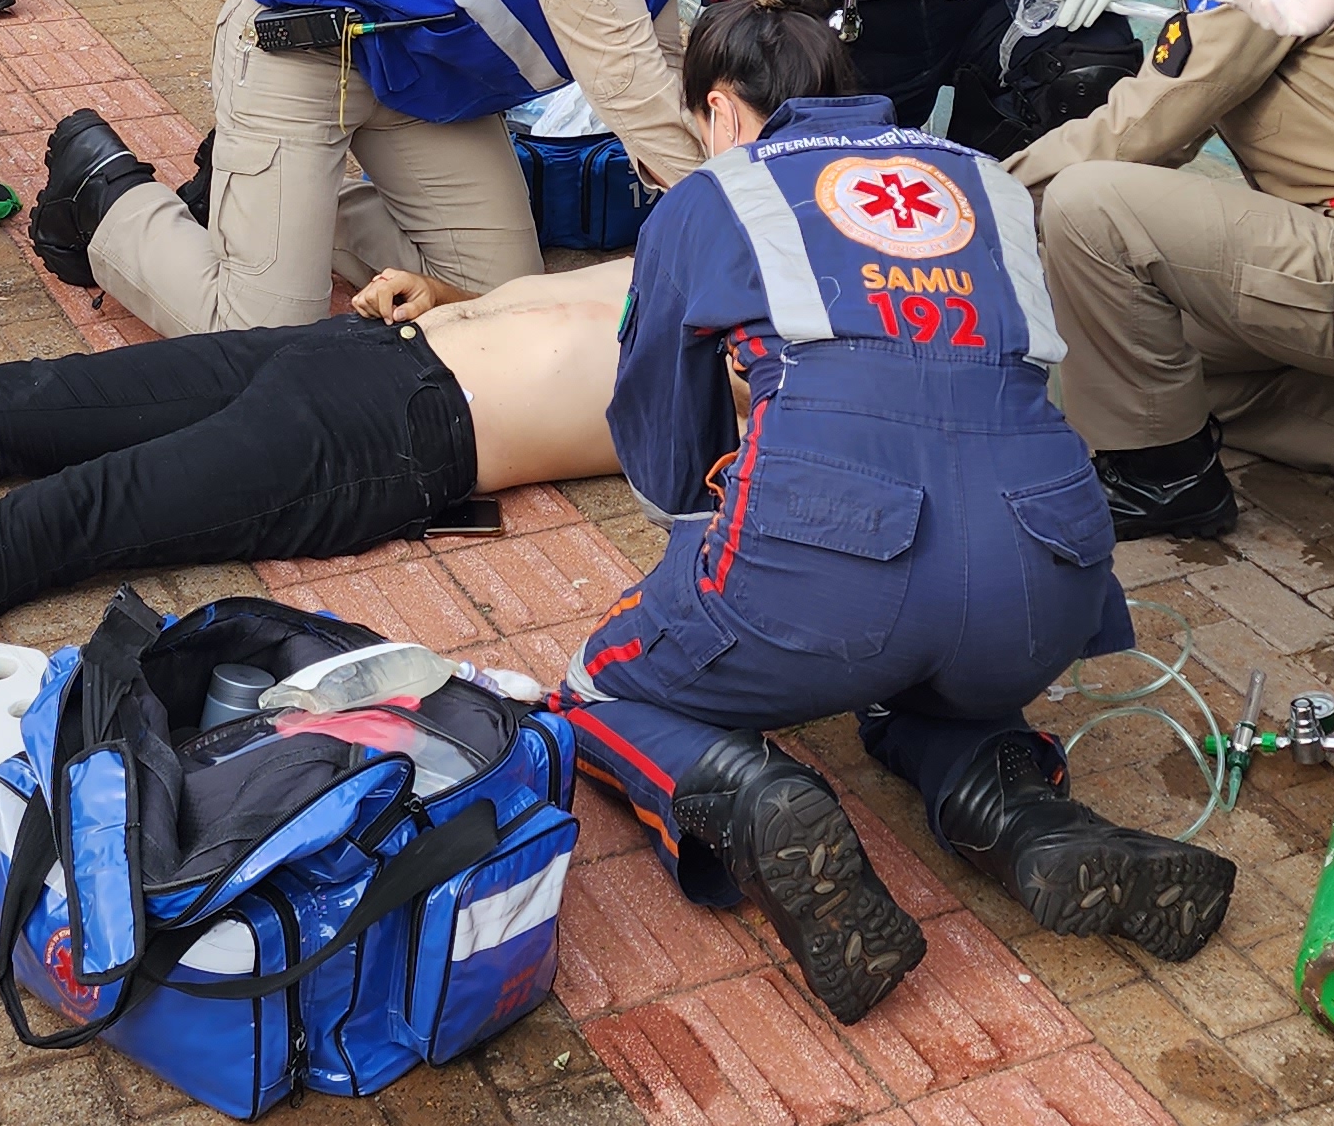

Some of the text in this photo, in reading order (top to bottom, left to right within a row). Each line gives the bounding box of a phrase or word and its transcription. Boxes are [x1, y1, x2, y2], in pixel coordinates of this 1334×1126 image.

[756, 135, 853, 160] ENFERMEIRA
[861, 263, 974, 296] SAMU
[868, 291, 986, 347] 192
